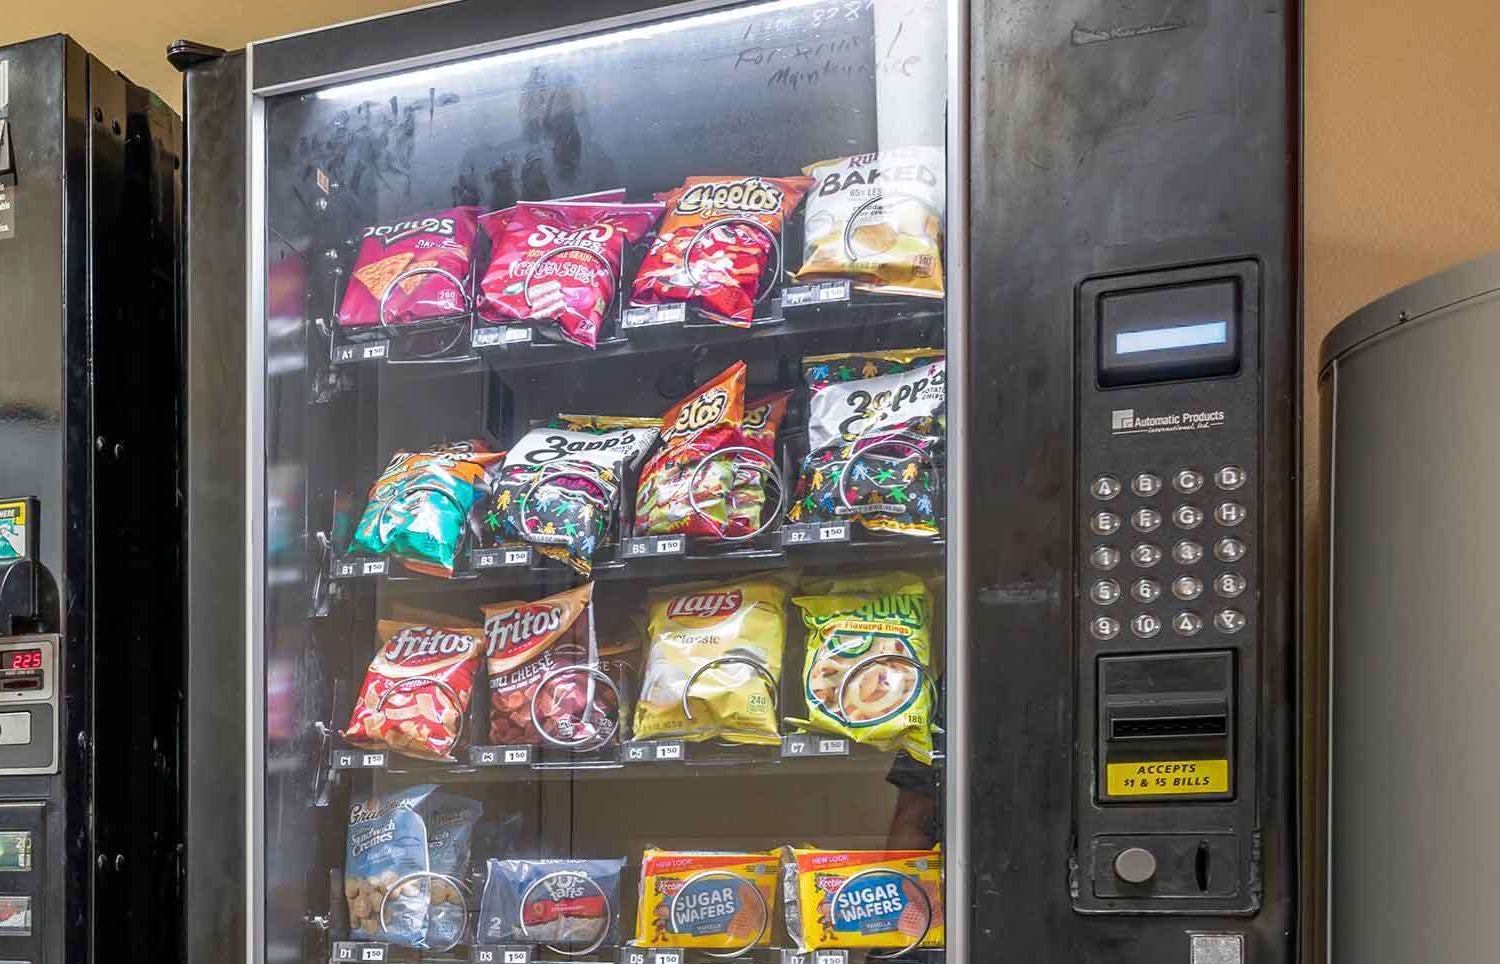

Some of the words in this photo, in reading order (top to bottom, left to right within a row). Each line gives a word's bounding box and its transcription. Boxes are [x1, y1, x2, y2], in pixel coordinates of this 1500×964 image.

[1135, 414, 1180, 428] Automatic
[1182, 410, 1224, 424] Products
[1099, 482, 1111, 495] A
[1140, 478, 1152, 491] B
[1180, 474, 1194, 488] C
[1222, 471, 1236, 484] D
[0, 508, 15, 518] HERE
[1099, 516, 1111, 530] E
[1140, 514, 1151, 527] F
[1180, 510, 1194, 523] G
[1222, 507, 1236, 520] H
[1101, 551, 1109, 565] 1
[1140, 549, 1151, 562] 2
[1223, 543, 1235, 556] 4
[1099, 585, 1110, 599] 5
[1140, 584, 1151, 597] 6
[1223, 579, 1235, 592] 8
[670, 592, 742, 617] Lay's
[485, 605, 562, 656] Fritos
[845, 622, 882, 631] Flavored
[1099, 621, 1110, 634] 9
[1136, 619, 1154, 632] 10
[385, 626, 473, 660] Fritos
[674, 633, 720, 645] Classic
[512, 652, 554, 683] CHEESE
[630, 749, 642, 758] C5
[791, 743, 804, 753] C7
[1137, 764, 1196, 775] ACCEPTS
[1124, 779, 1135, 788] $1
[1140, 779, 1148, 788] &
[1155, 778, 1167, 787] $5
[1173, 776, 1210, 787] BILLS
[676, 887, 734, 911] SUGAR
[838, 883, 899, 908] SUGAR
[676, 901, 735, 925] WAFERS
[840, 897, 902, 923] WAFERS
